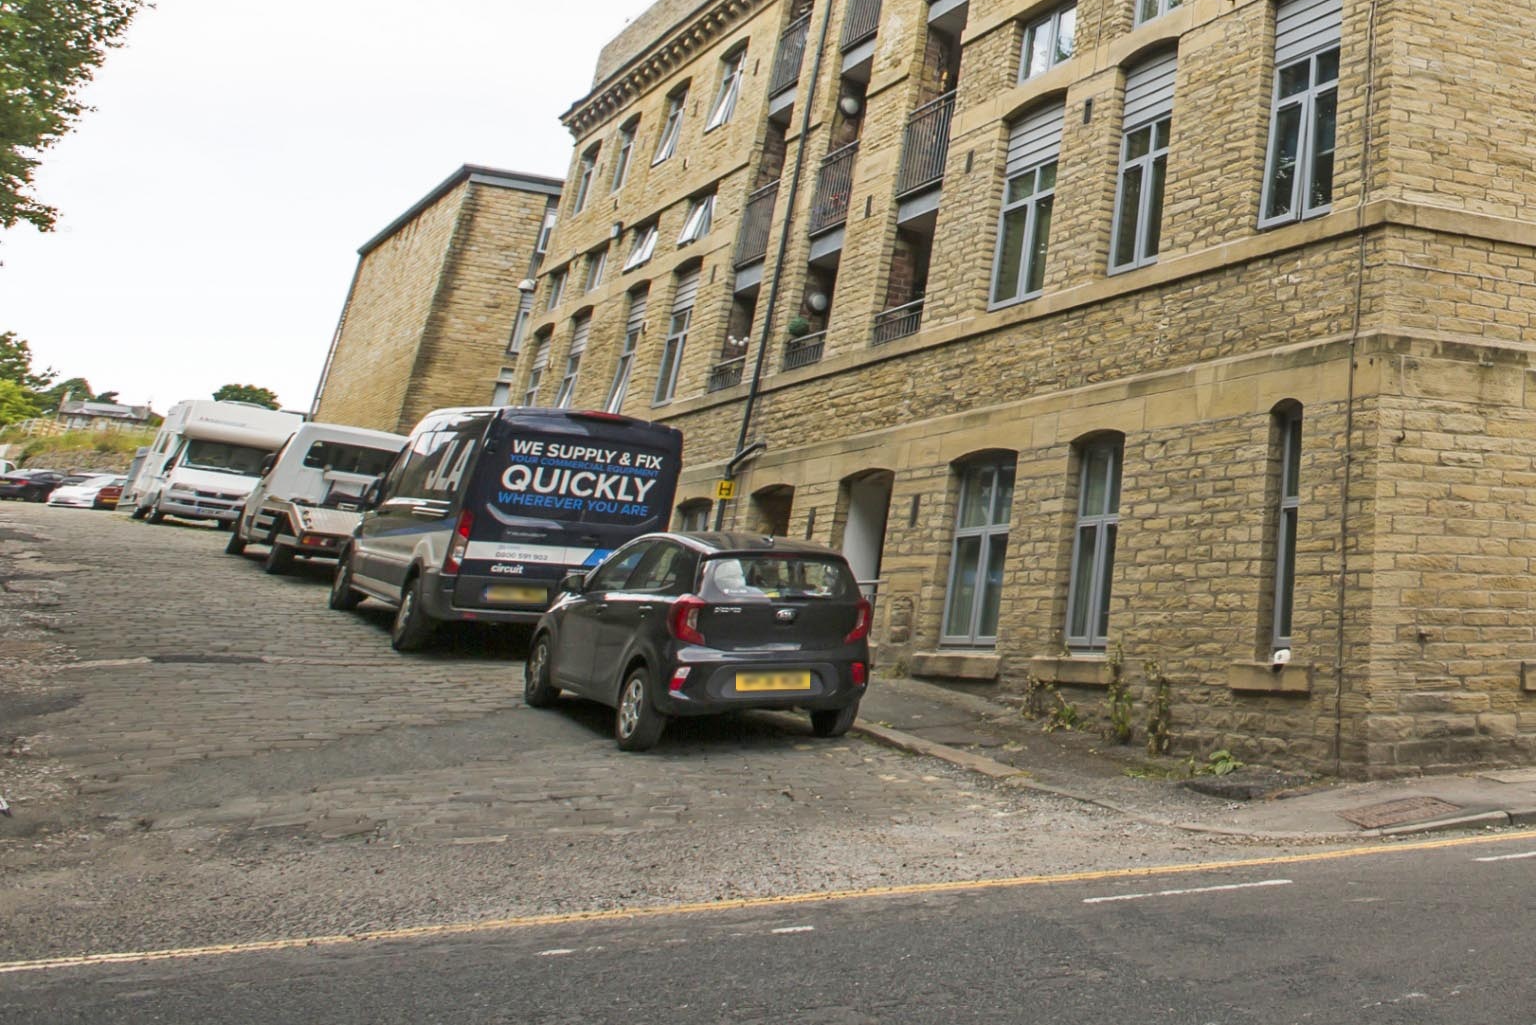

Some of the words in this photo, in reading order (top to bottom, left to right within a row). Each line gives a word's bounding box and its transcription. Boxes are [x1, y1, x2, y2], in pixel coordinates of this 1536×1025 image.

[424, 439, 476, 491] JLA
[510, 454, 538, 465] YOUR
[540, 457, 604, 472] COMMERCIAL
[607, 464, 659, 477] EQUIPMENT
[513, 439, 544, 456] WE
[547, 443, 616, 463] SUPPLY
[619, 451, 631, 466] &
[635, 453, 664, 470] FIX
[502, 464, 656, 503] QUICKLY
[719, 481, 733, 496] H
[498, 491, 583, 511] WHEREVER
[587, 499, 619, 514] YOU
[621, 503, 649, 517] ARE
[490, 563, 524, 574] circuit
